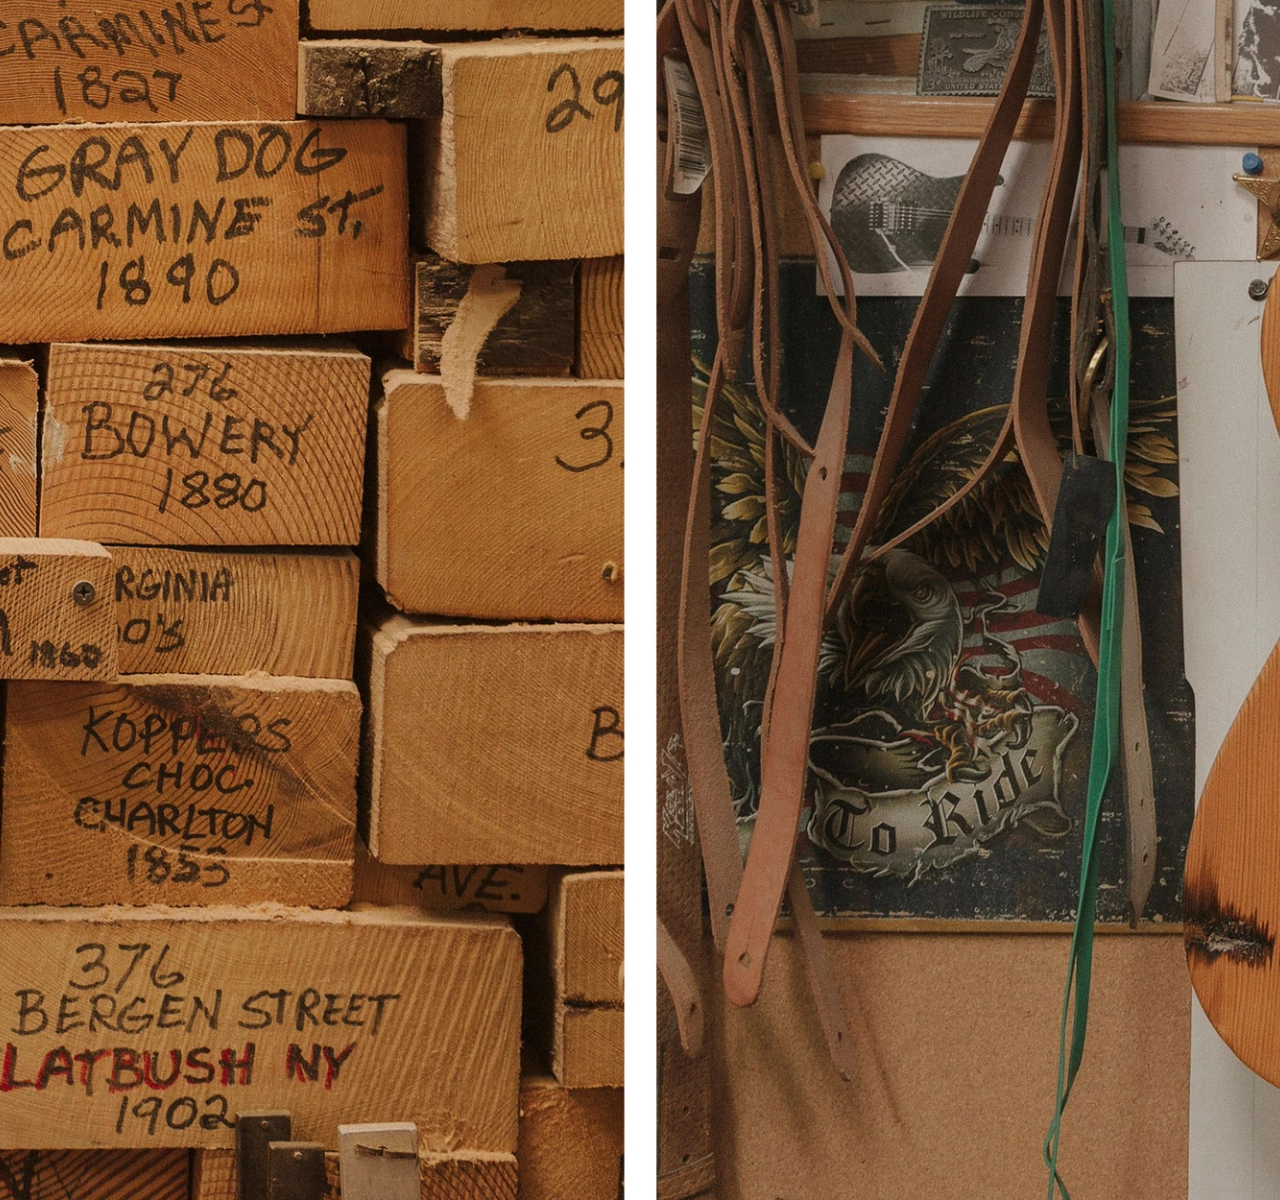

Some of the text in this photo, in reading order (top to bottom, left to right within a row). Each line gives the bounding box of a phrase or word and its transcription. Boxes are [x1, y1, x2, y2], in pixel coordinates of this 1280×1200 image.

[53, 64, 183, 115] 1827
[15, 125, 348, 204] GRAY DOG
[2, 194, 273, 262] CARMINE
[96, 253, 241, 310] 1890
[142, 361, 238, 403] 276
[81, 400, 317, 467] BOWERY
[68, 942, 185, 991] 376
[11, 988, 402, 1036] BERGEN STREET
[285, 1041, 358, 1092] NY
[115, 1094, 237, 1136] 1902
